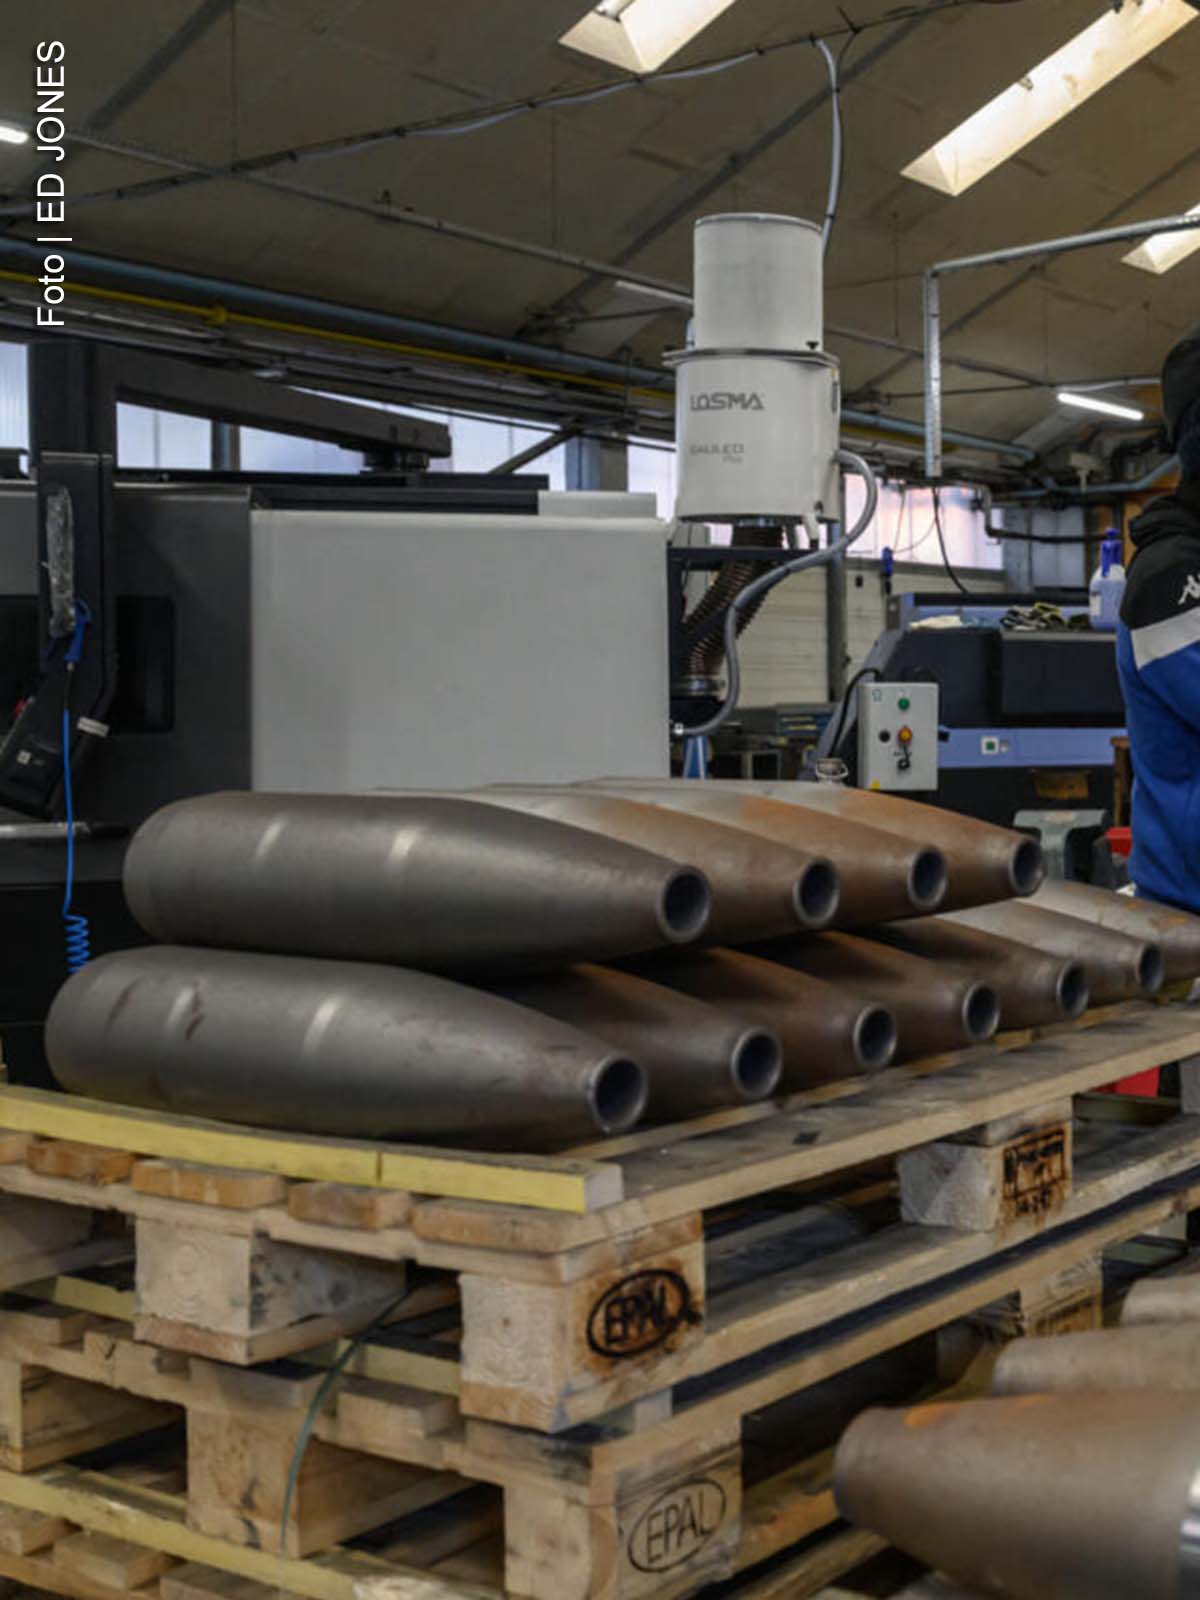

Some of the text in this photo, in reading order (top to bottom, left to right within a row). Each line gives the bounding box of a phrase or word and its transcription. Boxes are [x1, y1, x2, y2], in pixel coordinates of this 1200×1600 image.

[690, 392, 764, 411] LOSMA
[603, 1281, 679, 1346] EPAL
[646, 1487, 716, 1565] EPAL
